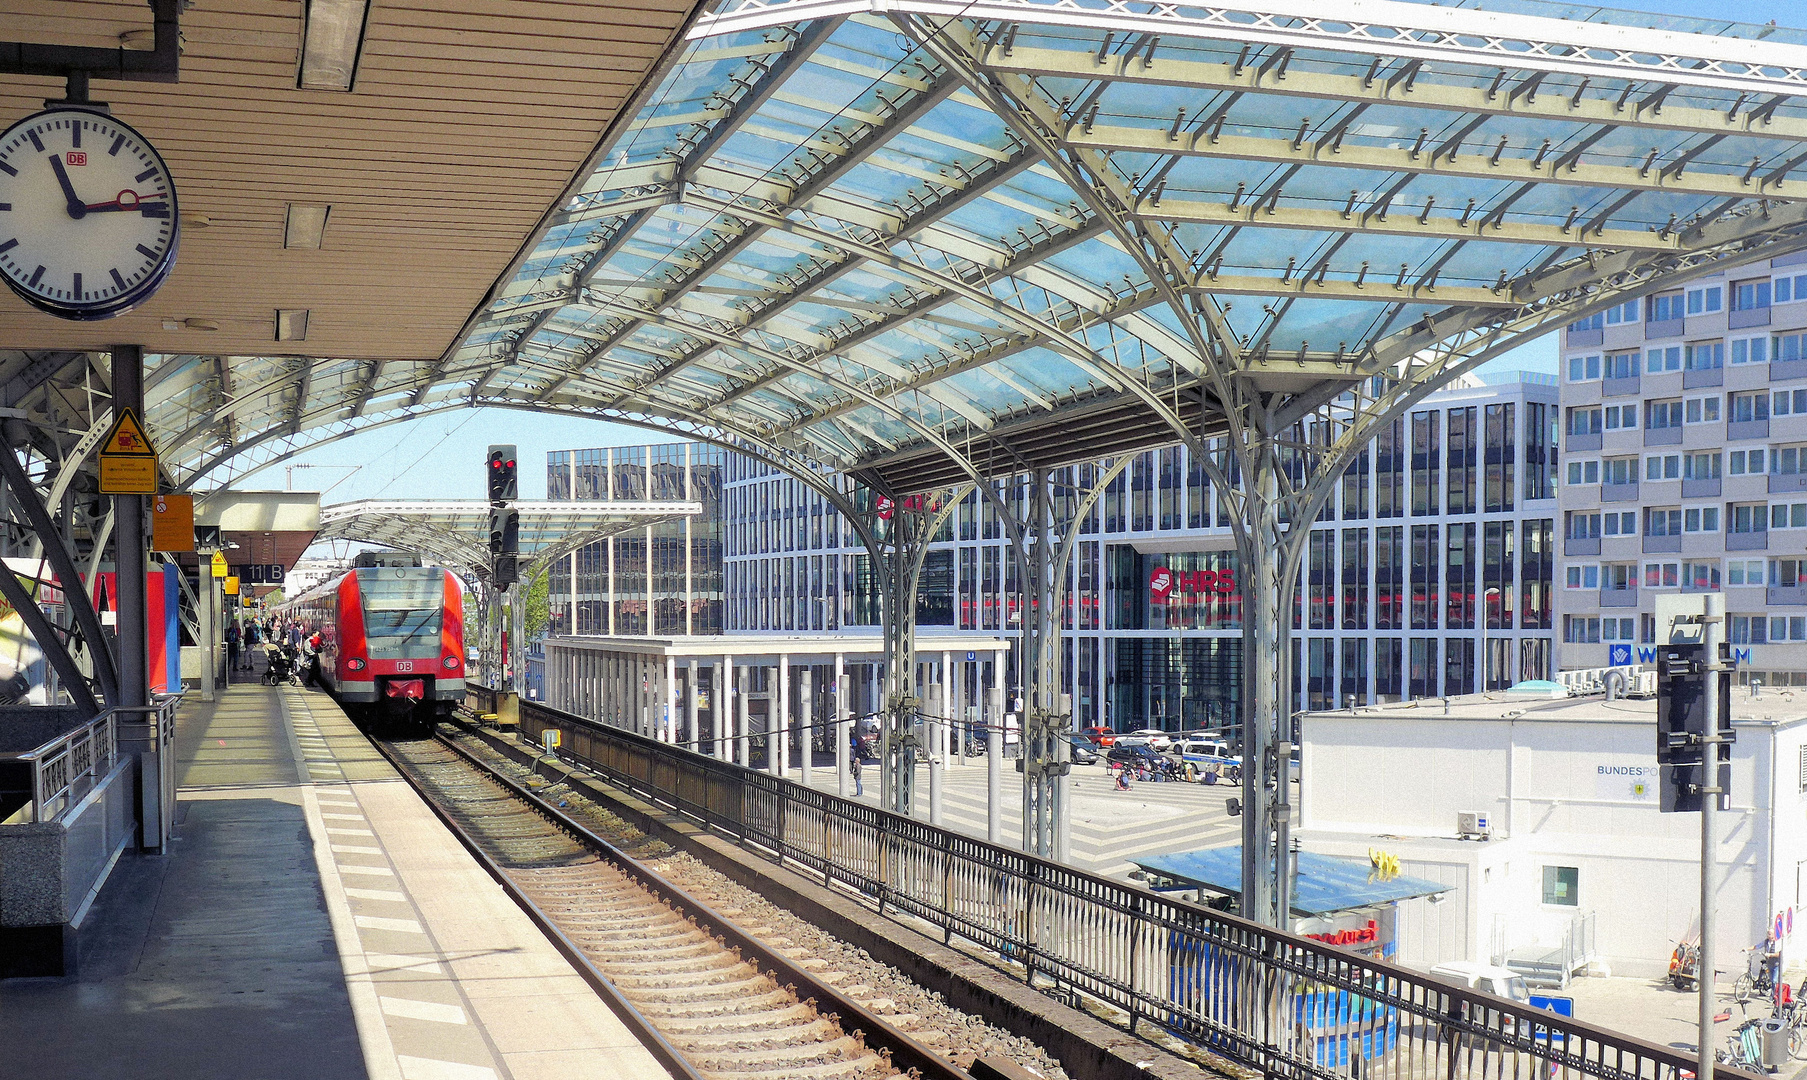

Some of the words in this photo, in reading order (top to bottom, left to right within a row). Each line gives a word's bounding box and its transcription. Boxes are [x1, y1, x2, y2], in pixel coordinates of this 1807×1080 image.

[69, 154, 85, 164] DB
[249, 565, 262, 579] 11
[271, 565, 282, 579] B
[1180, 569, 1235, 592] HRS
[398, 662, 412, 671] DB
[1597, 765, 1659, 777] BUNDESPO
